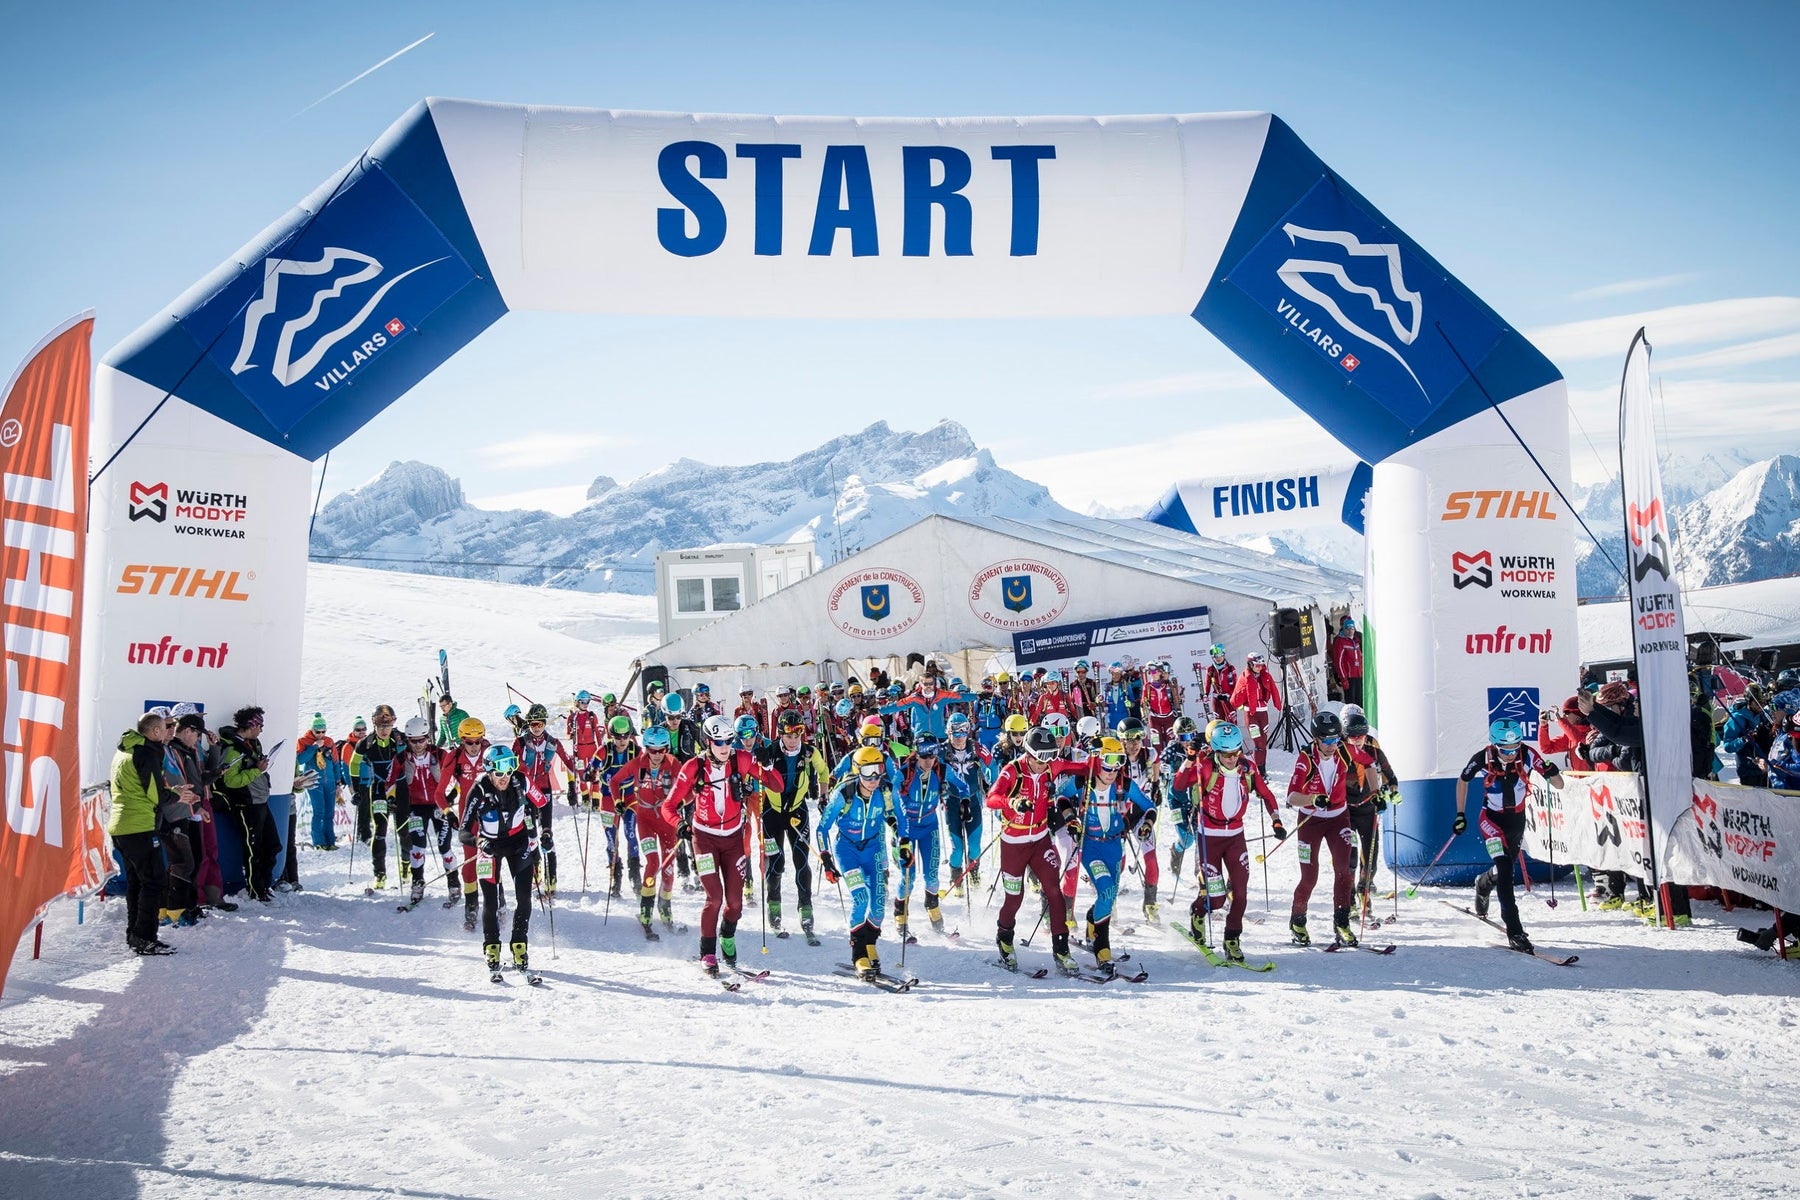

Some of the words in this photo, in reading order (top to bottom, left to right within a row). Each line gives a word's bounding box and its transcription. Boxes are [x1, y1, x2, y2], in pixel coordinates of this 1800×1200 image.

[656, 140, 1057, 258] START
[1276, 297, 1343, 358] VILLARS
[314, 332, 387, 391] VILLARS
[176, 489, 247, 509] WÜRTH
[1213, 475, 1320, 519] FINISH
[1441, 490, 1557, 521] STIHL
[175, 505, 246, 522] MODYF
[174, 525, 246, 539] WORKWEAR
[1499, 556, 1555, 570] WÜRTH
[117, 564, 249, 601] STIHL
[972, 566, 1003, 601] GROUPEMENT
[1004, 564, 1013, 573] de
[1013, 563, 1021, 571] la
[1021, 563, 1066, 595] CONSTRUCTION
[1500, 570, 1555, 583] MODYF
[831, 575, 863, 611] GROUPEMENT
[880, 572, 922, 604] CONSTRUCTION
[1500, 589, 1557, 599] WORKWEAR
[842, 616, 913, 636] Ormont-Dessus
[983, 608, 1058, 627] Ormont-Dessus
[4, 423, 75, 848] STIHL
[1127, 627, 1150, 635] VILLARS
